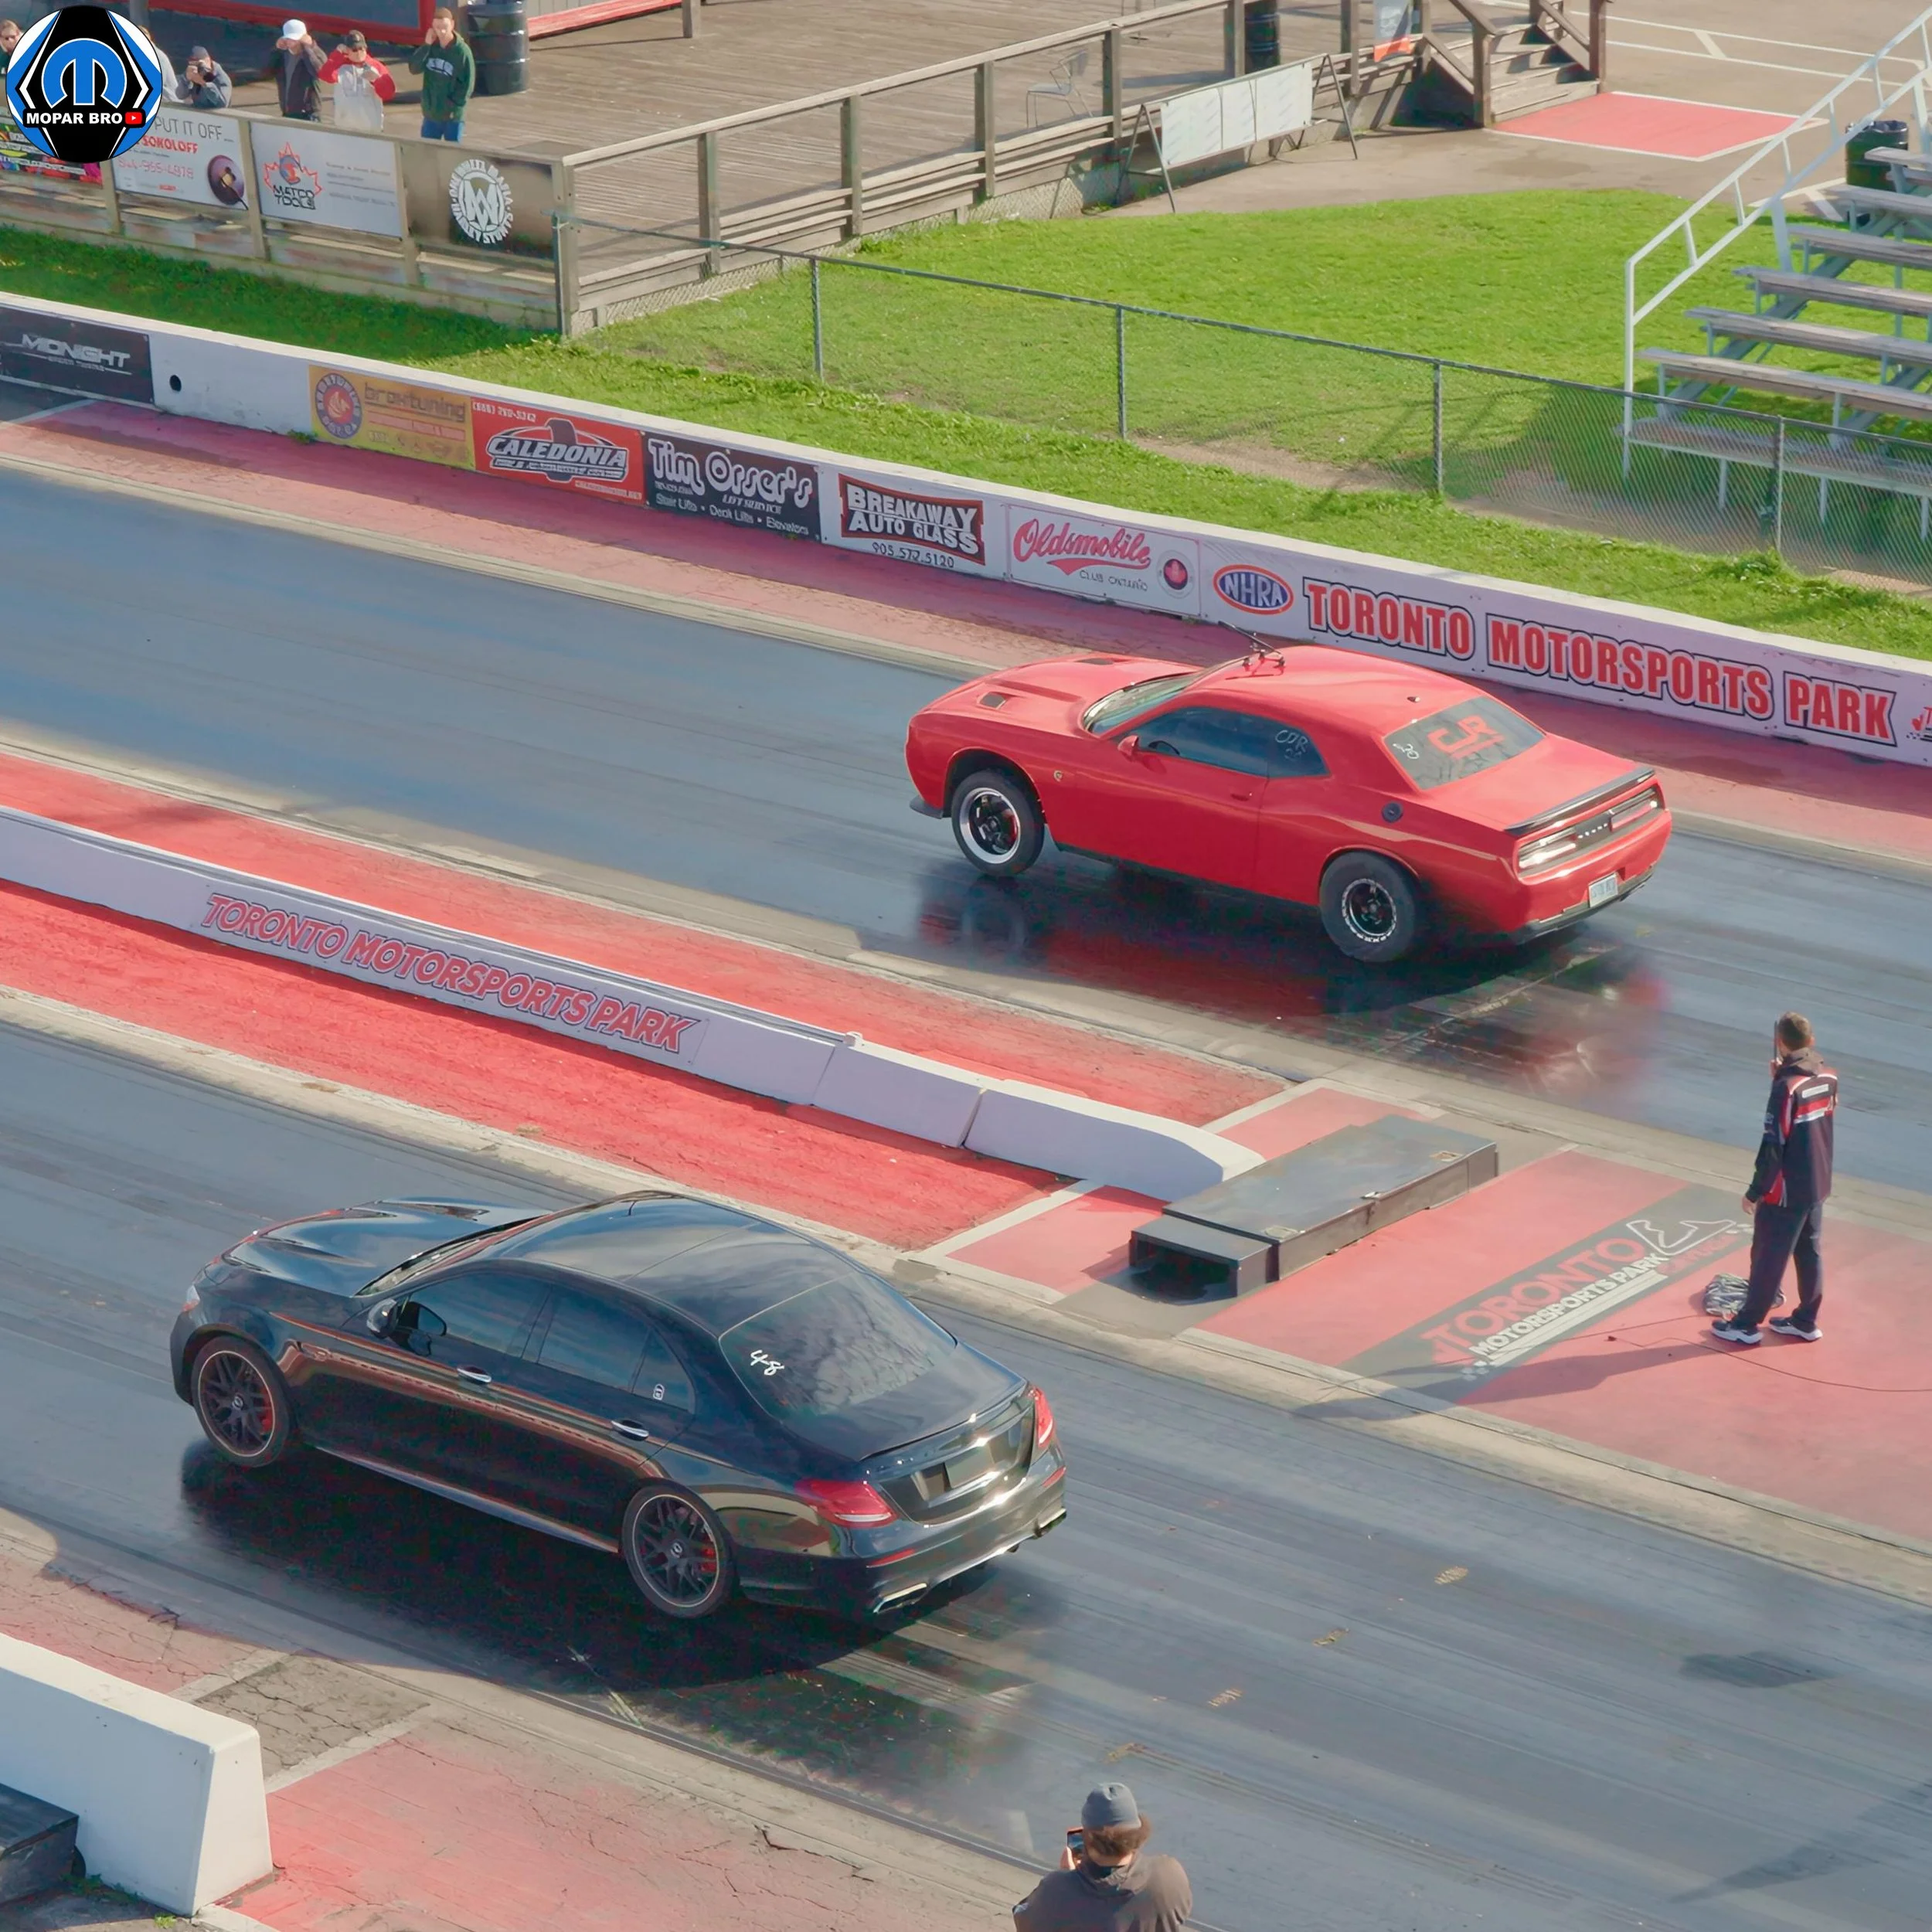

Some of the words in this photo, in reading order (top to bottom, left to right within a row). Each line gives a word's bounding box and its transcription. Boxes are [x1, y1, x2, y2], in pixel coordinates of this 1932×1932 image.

[182, 121, 195, 136] IT
[198, 123, 223, 141] OFF
[274, 194, 316, 210] TOOLS
[488, 437, 628, 468] CALEDONIA
[648, 438, 706, 496] Tim
[847, 483, 978, 532] BREAKAWAY
[849, 511, 905, 536] AUTO
[913, 523, 978, 554] GLASS
[1013, 519, 1151, 563] Oldsmobile
[1222, 572, 1285, 607] NHRA
[1304, 580, 1473, 657] TORONTO
[1488, 617, 1771, 718] MOTORSPORTS
[1786, 676, 1896, 743] PARK
[202, 894, 348, 958] TORONTO
[342, 933, 598, 1026] MOTORSPORTS
[587, 996, 699, 1053] PARK
[1429, 1236, 1645, 1347] TORONTO
[1470, 1274, 1620, 1357] MOTORSPORTS
[1608, 1253, 1670, 1286] PARK
[750, 1349, 785, 1376] 48
